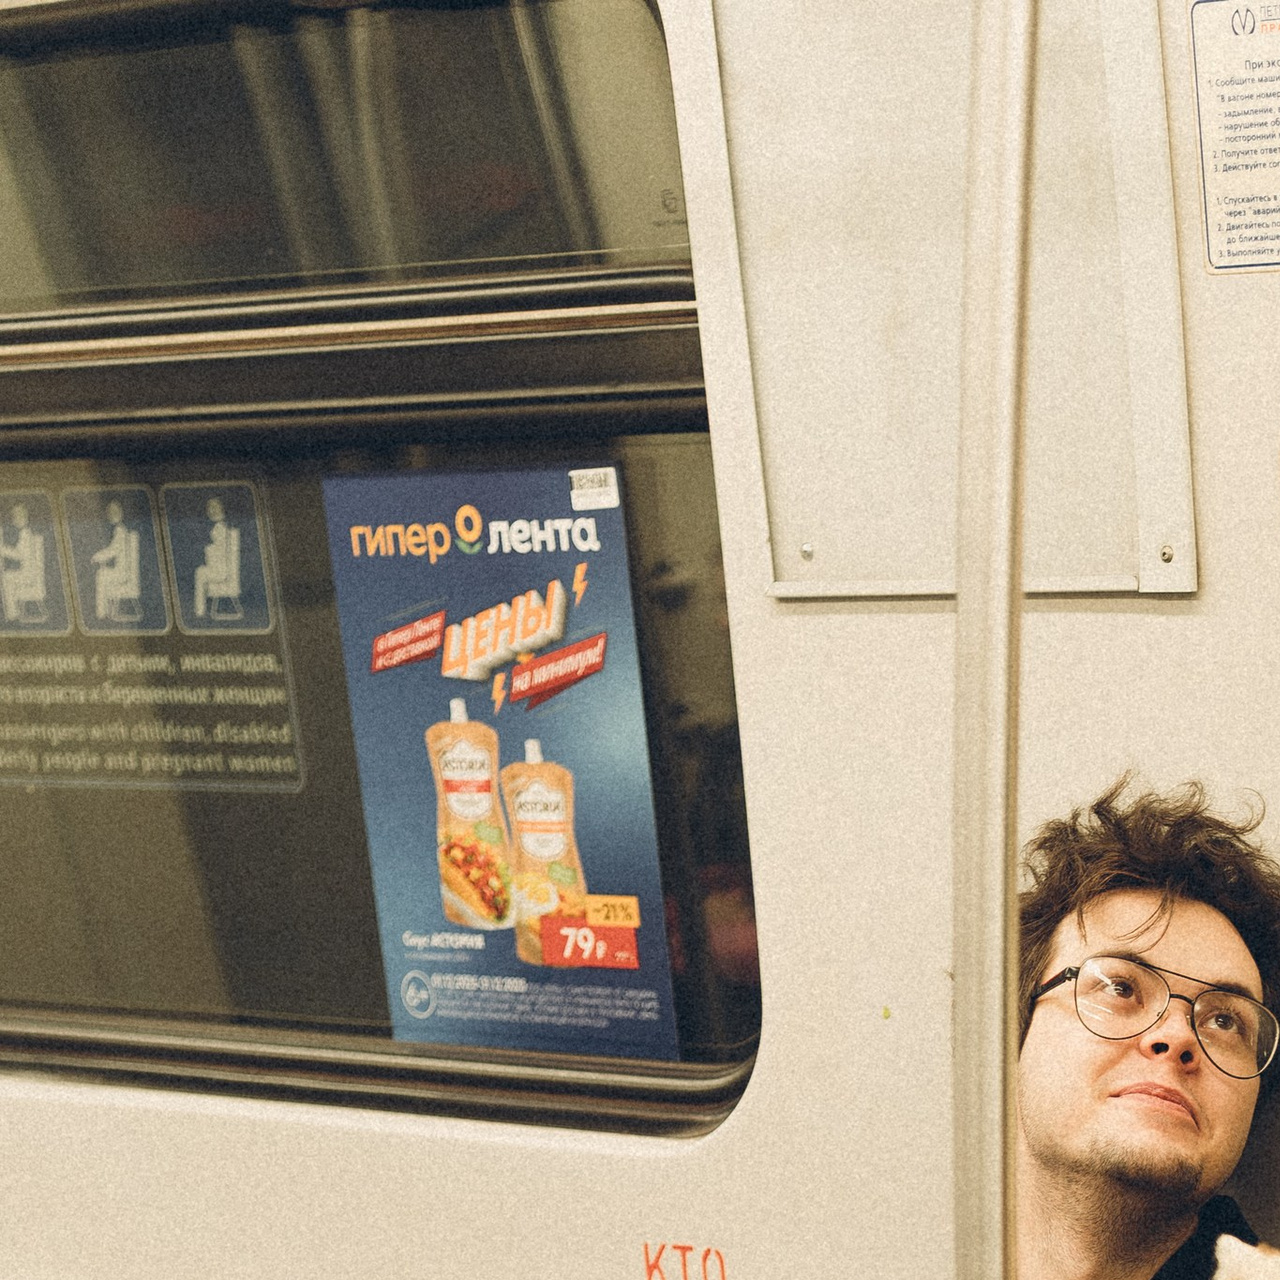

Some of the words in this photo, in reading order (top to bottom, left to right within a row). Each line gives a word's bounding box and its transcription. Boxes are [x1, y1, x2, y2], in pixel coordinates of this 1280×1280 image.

[1245, 59, 1263, 71] При
[1215, 76, 1256, 88] Сообщите
[1228, 91, 1254, 102] вагоне
[1225, 120, 1268, 132] нарушение
[1225, 131, 1275, 144] посторонний
[1222, 148, 1258, 160] Получите
[1260, 147, 1280, 155] ответ
[1222, 159, 1267, 172] Действуйте
[1224, 192, 1270, 206] Спускайтесь
[1225, 208, 1247, 220] через
[1226, 218, 1270, 232] Двигайтесь
[1227, 236, 1236, 246] до
[1227, 244, 1275, 258] Выполняйте
[351, 522, 452, 565] гипер
[487, 517, 601, 555] лента
[441, 579, 566, 679] ЦЕНЫ
[512, 670, 532, 694] на
[532, 638, 605, 687] минимум!
